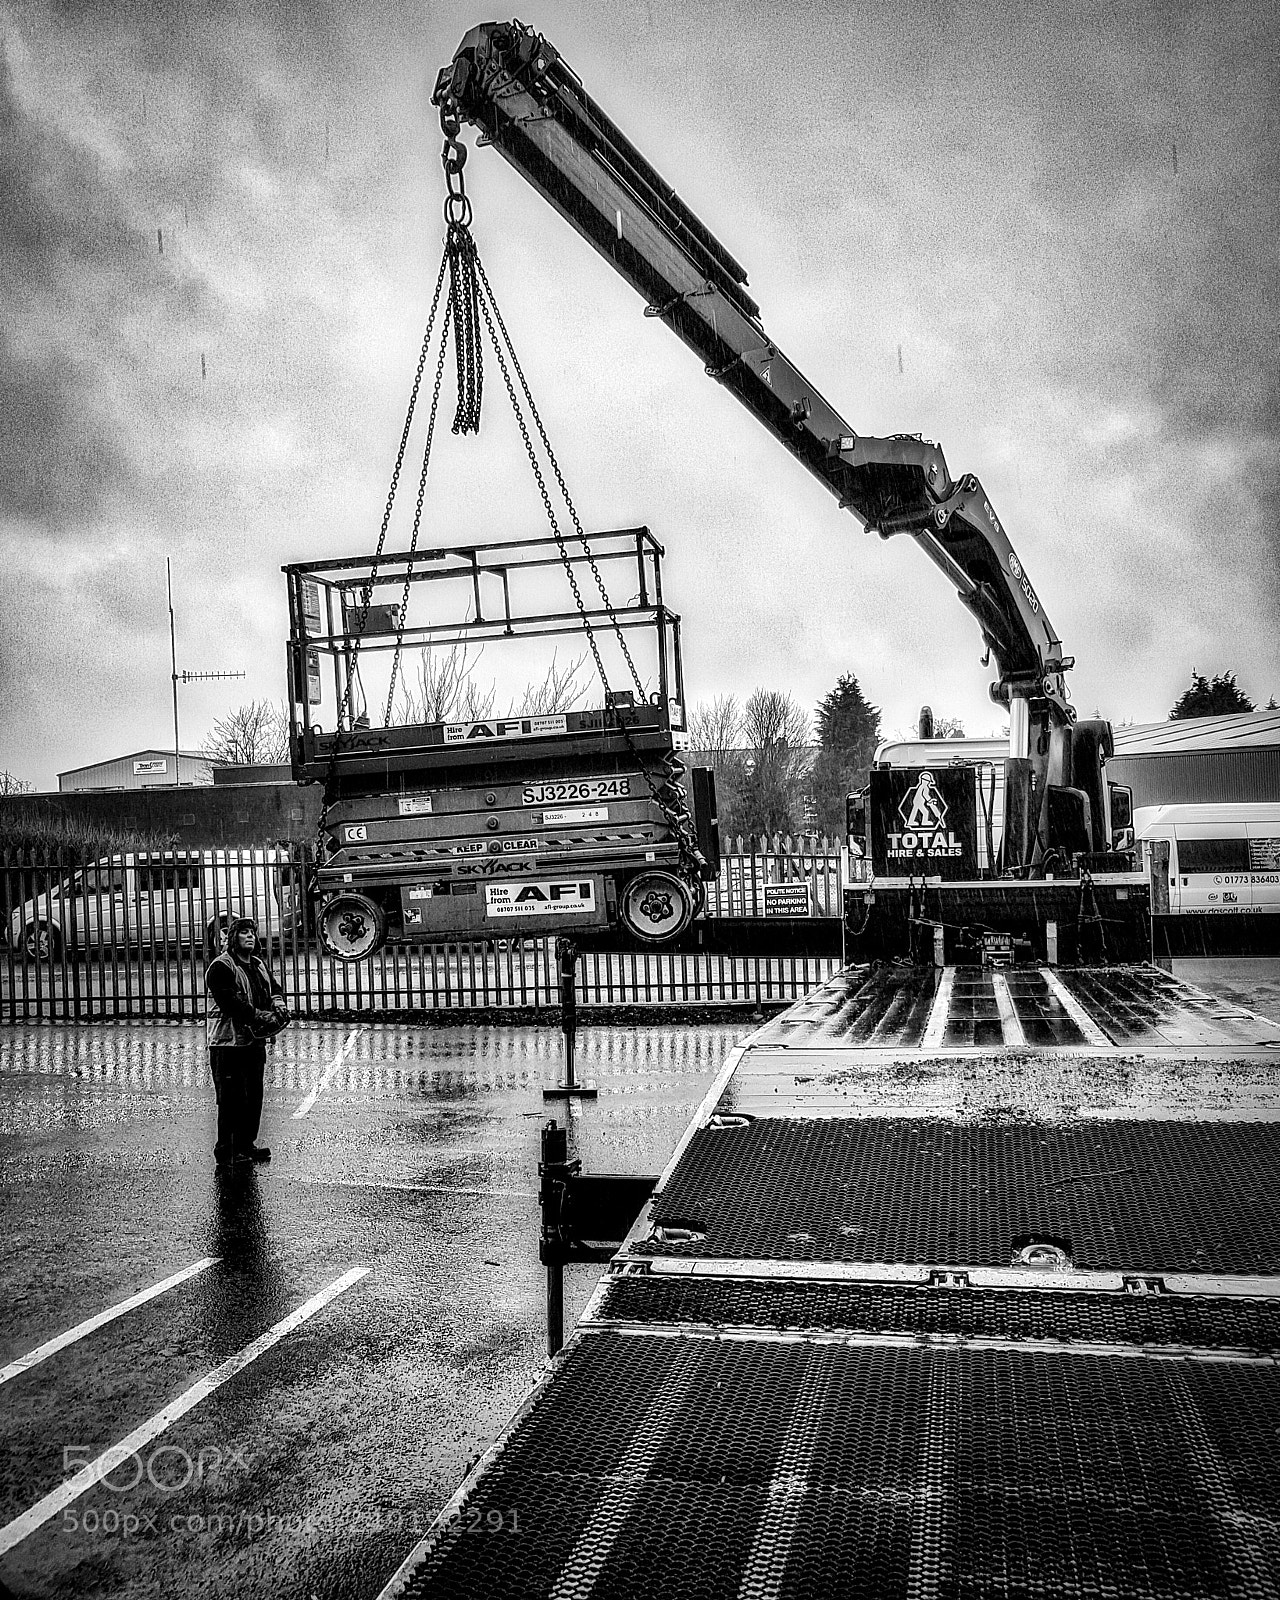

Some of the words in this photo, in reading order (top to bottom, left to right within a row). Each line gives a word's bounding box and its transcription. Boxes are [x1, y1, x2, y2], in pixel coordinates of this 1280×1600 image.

[466, 720, 532, 739] AFI
[522, 780, 631, 803] SJ3226-248
[347, 827, 364, 840] CE
[456, 843, 483, 853] KEEP
[503, 840, 537, 850] CLEAR
[887, 832, 962, 849] TOTAL
[887, 849, 913, 858] HIRE
[915, 848, 925, 857] &
[927, 848, 962, 857] SALES
[457, 858, 533, 875] SKYJACK
[1224, 875, 1249, 884] 01773
[1250, 875, 1279, 883] 836403
[489, 888, 509, 896] Hire
[513, 883, 591, 902] AFI
[777, 897, 807, 905] PARKING
